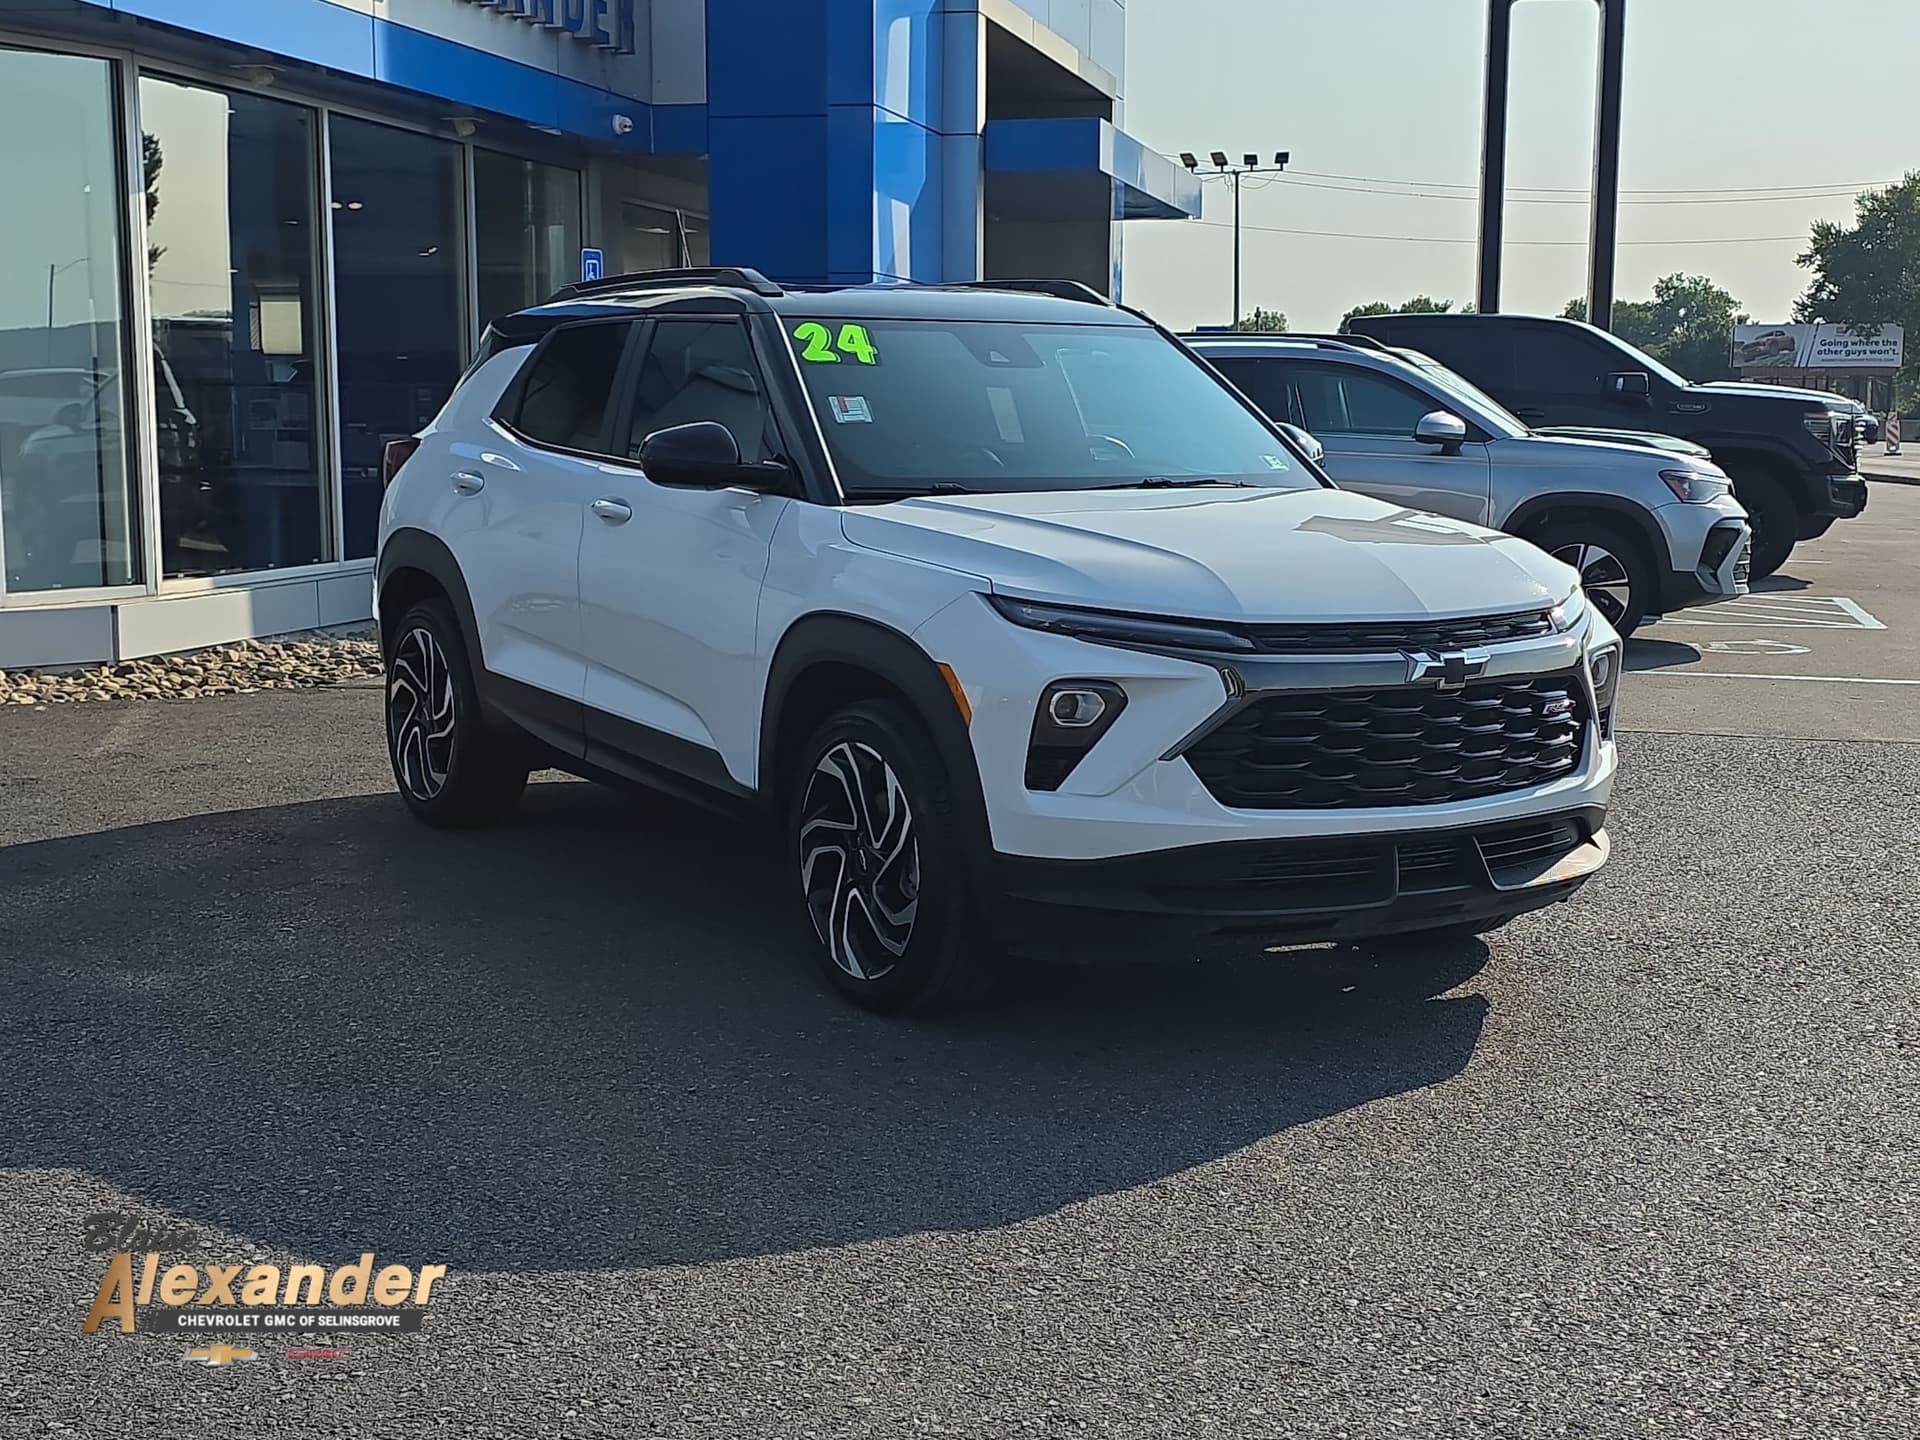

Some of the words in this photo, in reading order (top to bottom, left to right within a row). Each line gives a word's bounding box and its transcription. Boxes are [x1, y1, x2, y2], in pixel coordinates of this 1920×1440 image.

[793, 322, 878, 364] 24
[1820, 338, 1849, 348] Going
[1851, 338, 1880, 347] where
[1882, 338, 1898, 347] the
[1817, 348, 1843, 356] other
[1845, 349, 1867, 357] guys
[1869, 347, 1899, 356] won't.
